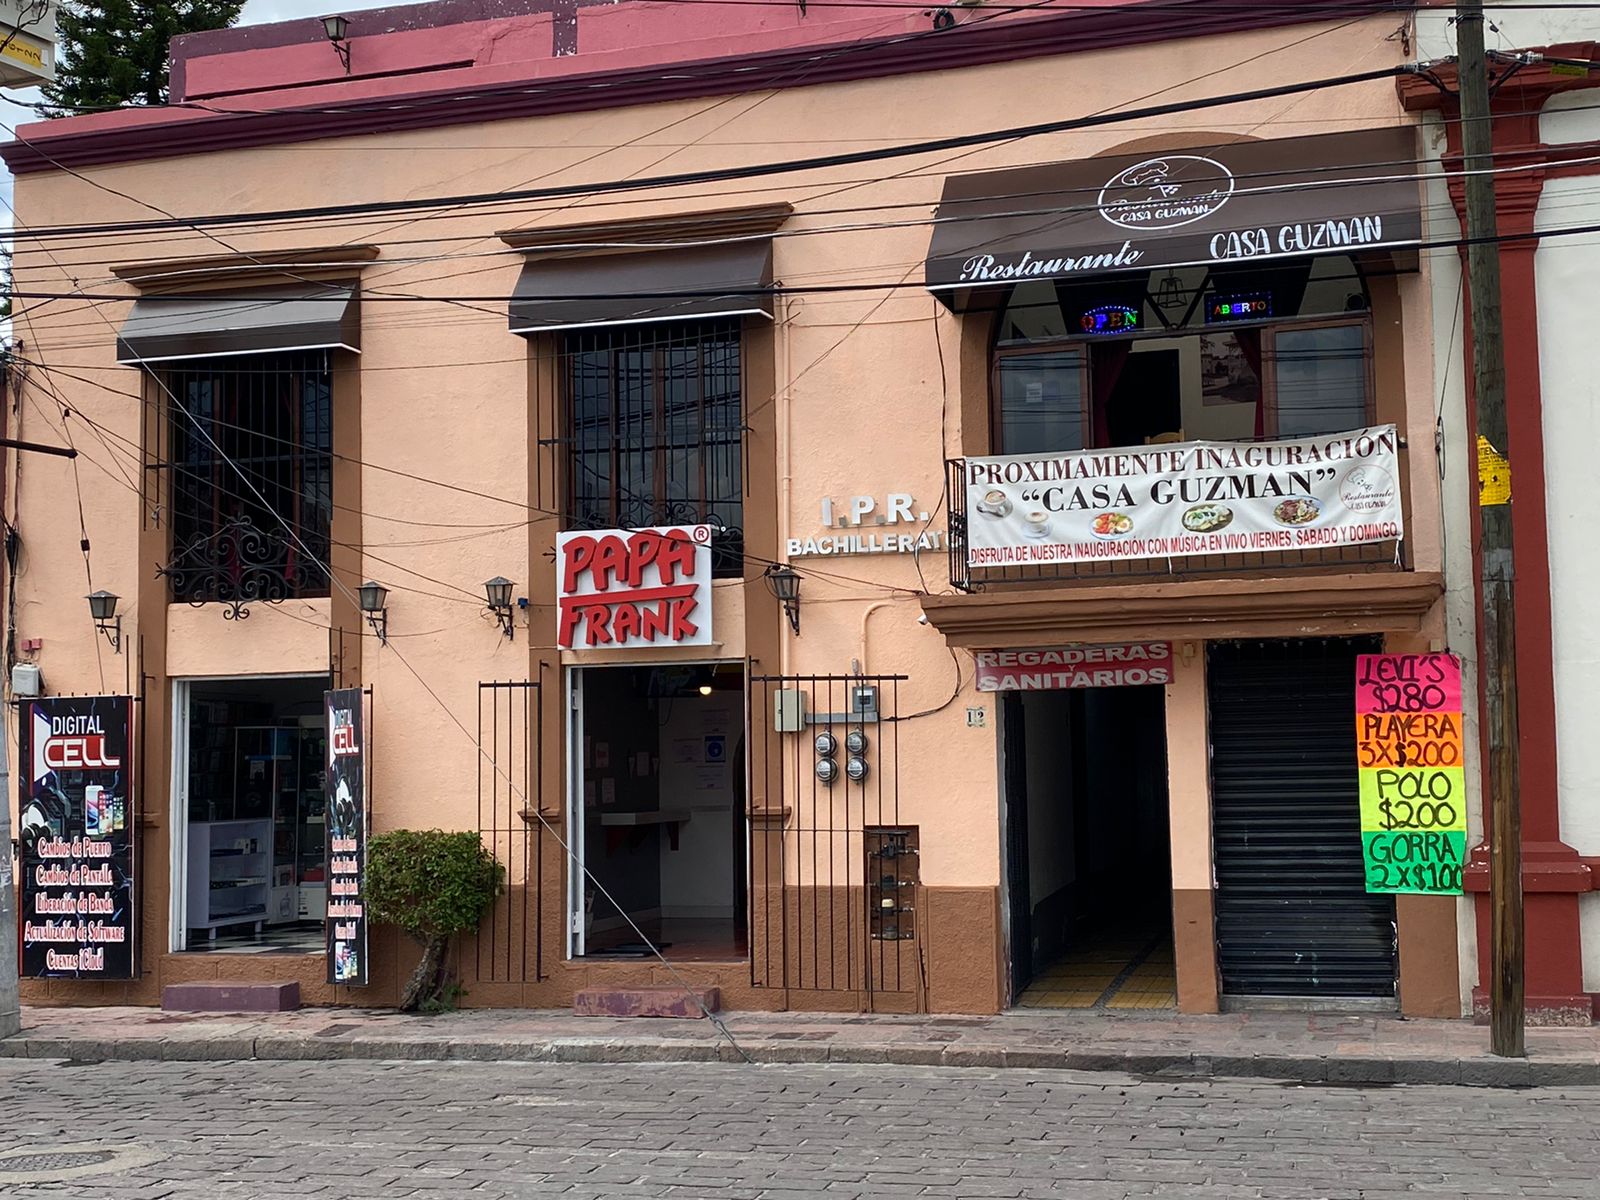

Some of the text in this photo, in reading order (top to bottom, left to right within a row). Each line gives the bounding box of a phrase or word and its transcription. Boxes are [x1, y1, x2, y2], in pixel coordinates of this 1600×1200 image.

[1119, 204, 1209, 223] CASA GUZMAN
[1210, 215, 1383, 260] CASA GUZMAN
[960, 240, 1144, 281] Restaurante
[1080, 311, 1138, 331] OPEN
[970, 429, 1395, 485] PROXIMAMENTE INAGURACIÓN
[822, 493, 929, 527] I.P.R.
[971, 546, 1014, 564] DISFRUTA
[1016, 546, 1028, 561] DE
[1030, 543, 1073, 560] NUESTRA
[1075, 536, 1146, 557] INAUGURACIÓN
[1148, 538, 1168, 554] CON
[1170, 533, 1207, 553] MÚSICA
[1210, 535, 1221, 551] EN
[1224, 533, 1248, 549] VIVO
[1297, 527, 1338, 545] SABADO
[1340, 526, 1347, 542] Y
[1350, 522, 1398, 541] DOMINGO
[562, 528, 697, 594] PAPA
[558, 597, 699, 648] FRANK
[977, 643, 1168, 668] REGADERAS
[1068, 664, 1076, 672] Y
[978, 667, 1169, 691] SANITARIOS
[1373, 684, 1446, 713] $280
[52, 715, 105, 735] DIGITAL
[967, 710, 985, 724] 12
[1364, 714, 1458, 742] PLAYERA
[44, 738, 120, 767] CELL
[1376, 769, 1452, 801] POLO
[1378, 797, 1457, 831] $200
[1369, 831, 1457, 864] GORRA
